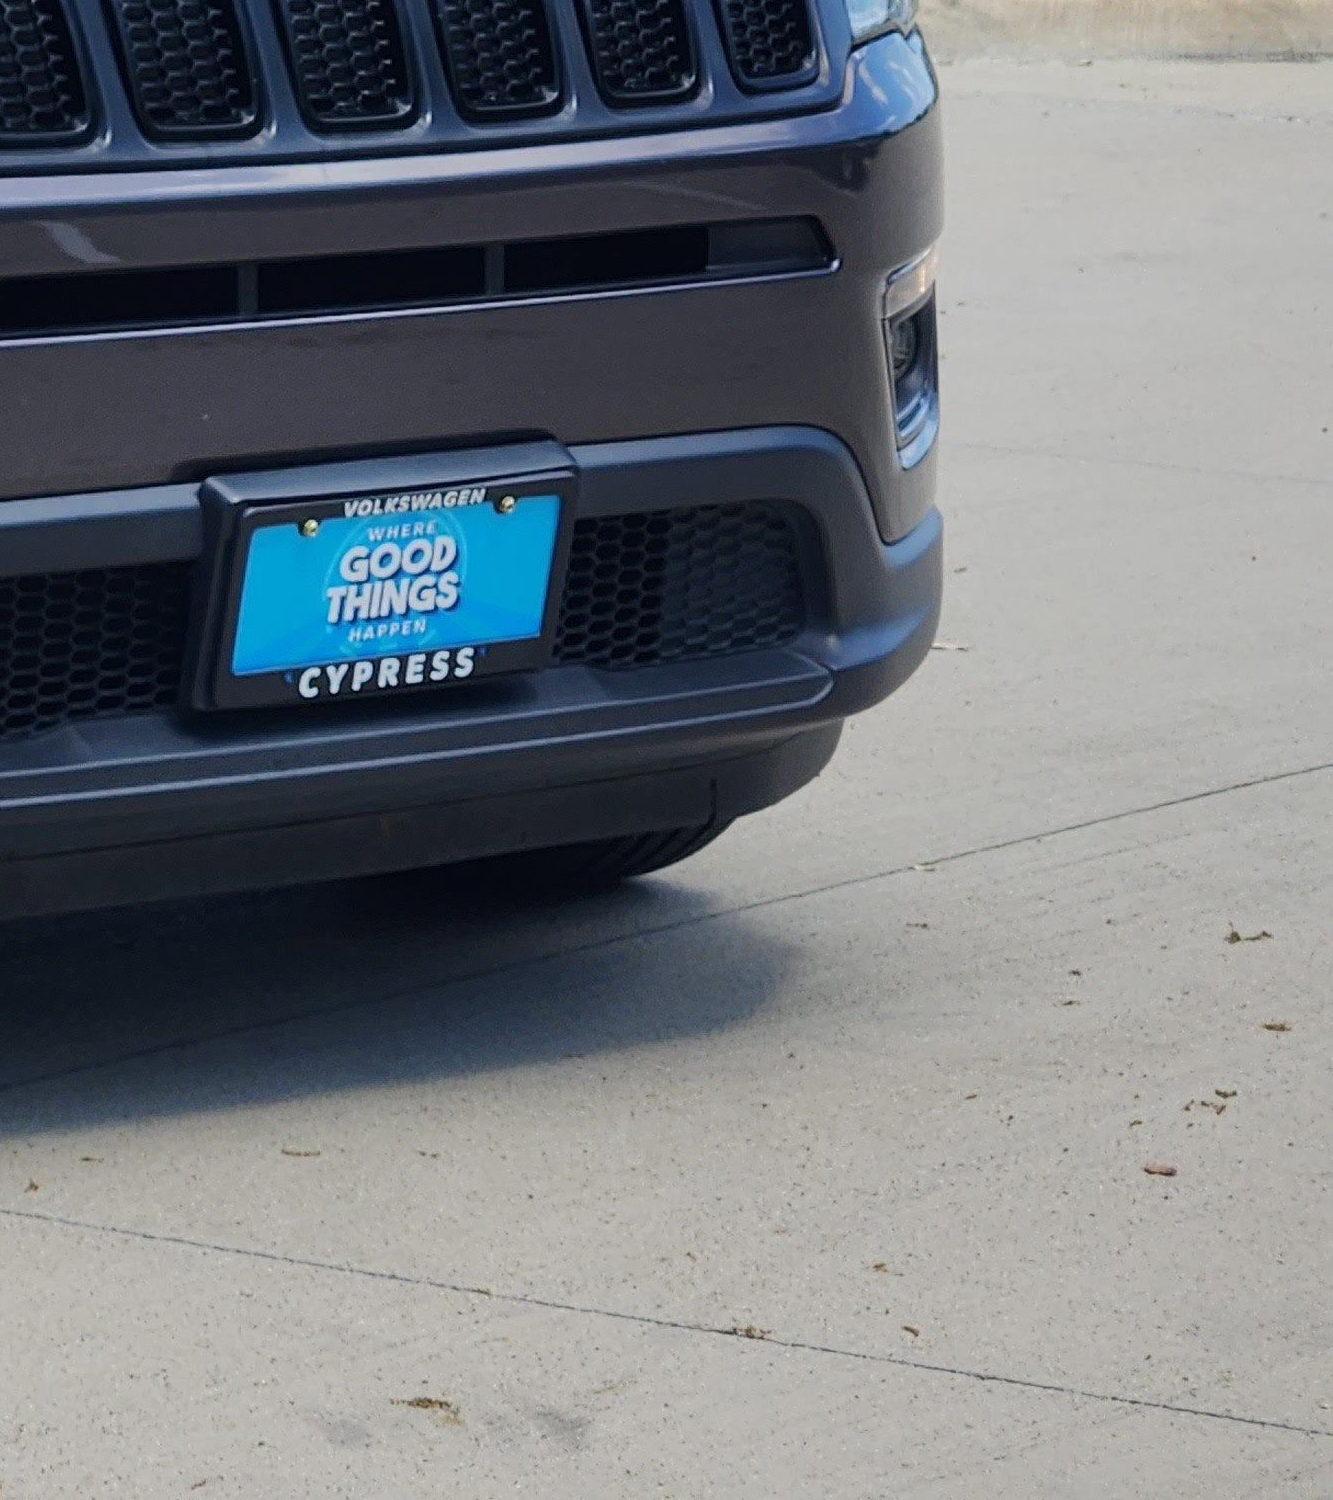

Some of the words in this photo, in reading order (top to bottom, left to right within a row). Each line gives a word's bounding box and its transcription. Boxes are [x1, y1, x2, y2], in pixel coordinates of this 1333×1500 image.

[344, 488, 487, 518] VOLKSWAGEN
[367, 519, 439, 542] WHERE
[339, 535, 458, 583] GOOD
[325, 571, 460, 624] THINGS
[348, 618, 427, 643] HAPPEN
[298, 646, 476, 699] CYPRESS
